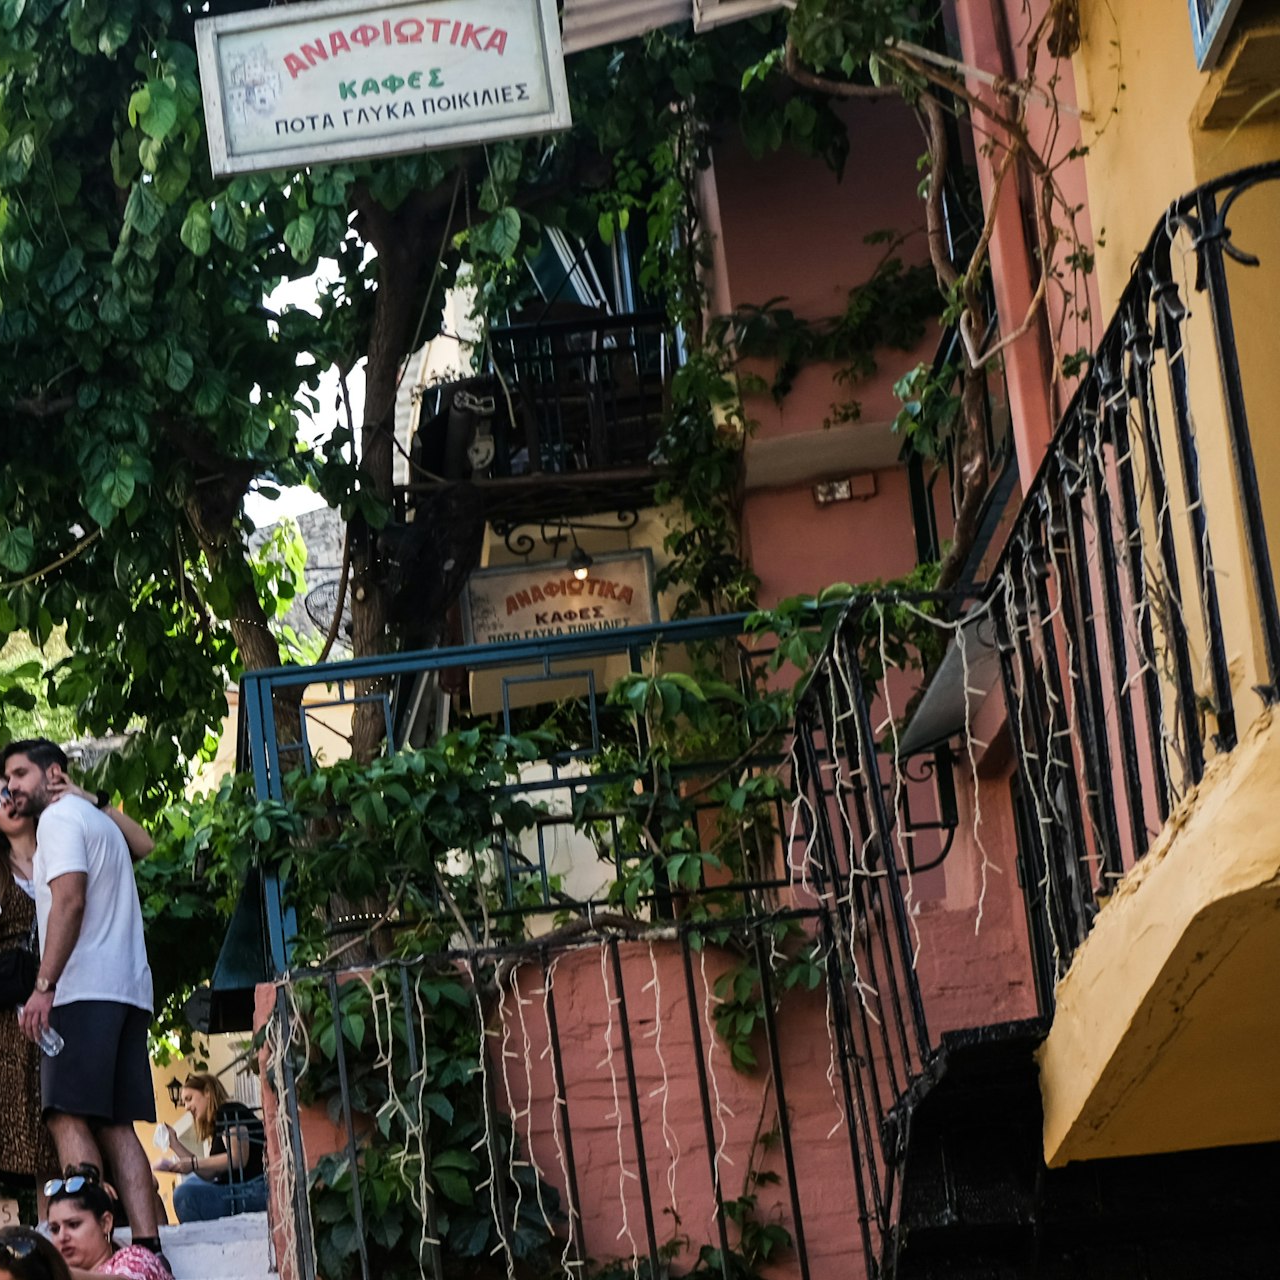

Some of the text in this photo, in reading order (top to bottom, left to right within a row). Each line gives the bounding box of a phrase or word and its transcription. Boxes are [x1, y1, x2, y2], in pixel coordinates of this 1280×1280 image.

[282, 17, 508, 80] ΑΝΑΦΙΩΤΙΚΑ
[338, 67, 445, 101] ΚΑΦΕΣ
[274, 82, 531, 137] ΠΟΤΑ ΓΛΥΚΑ ΠΟΙΚΙΛΙΕΣ
[504, 577, 634, 617] ΑΝΑΦΙΩΤΙΚΑ
[535, 605, 605, 626] ΚΑΦΕΣ
